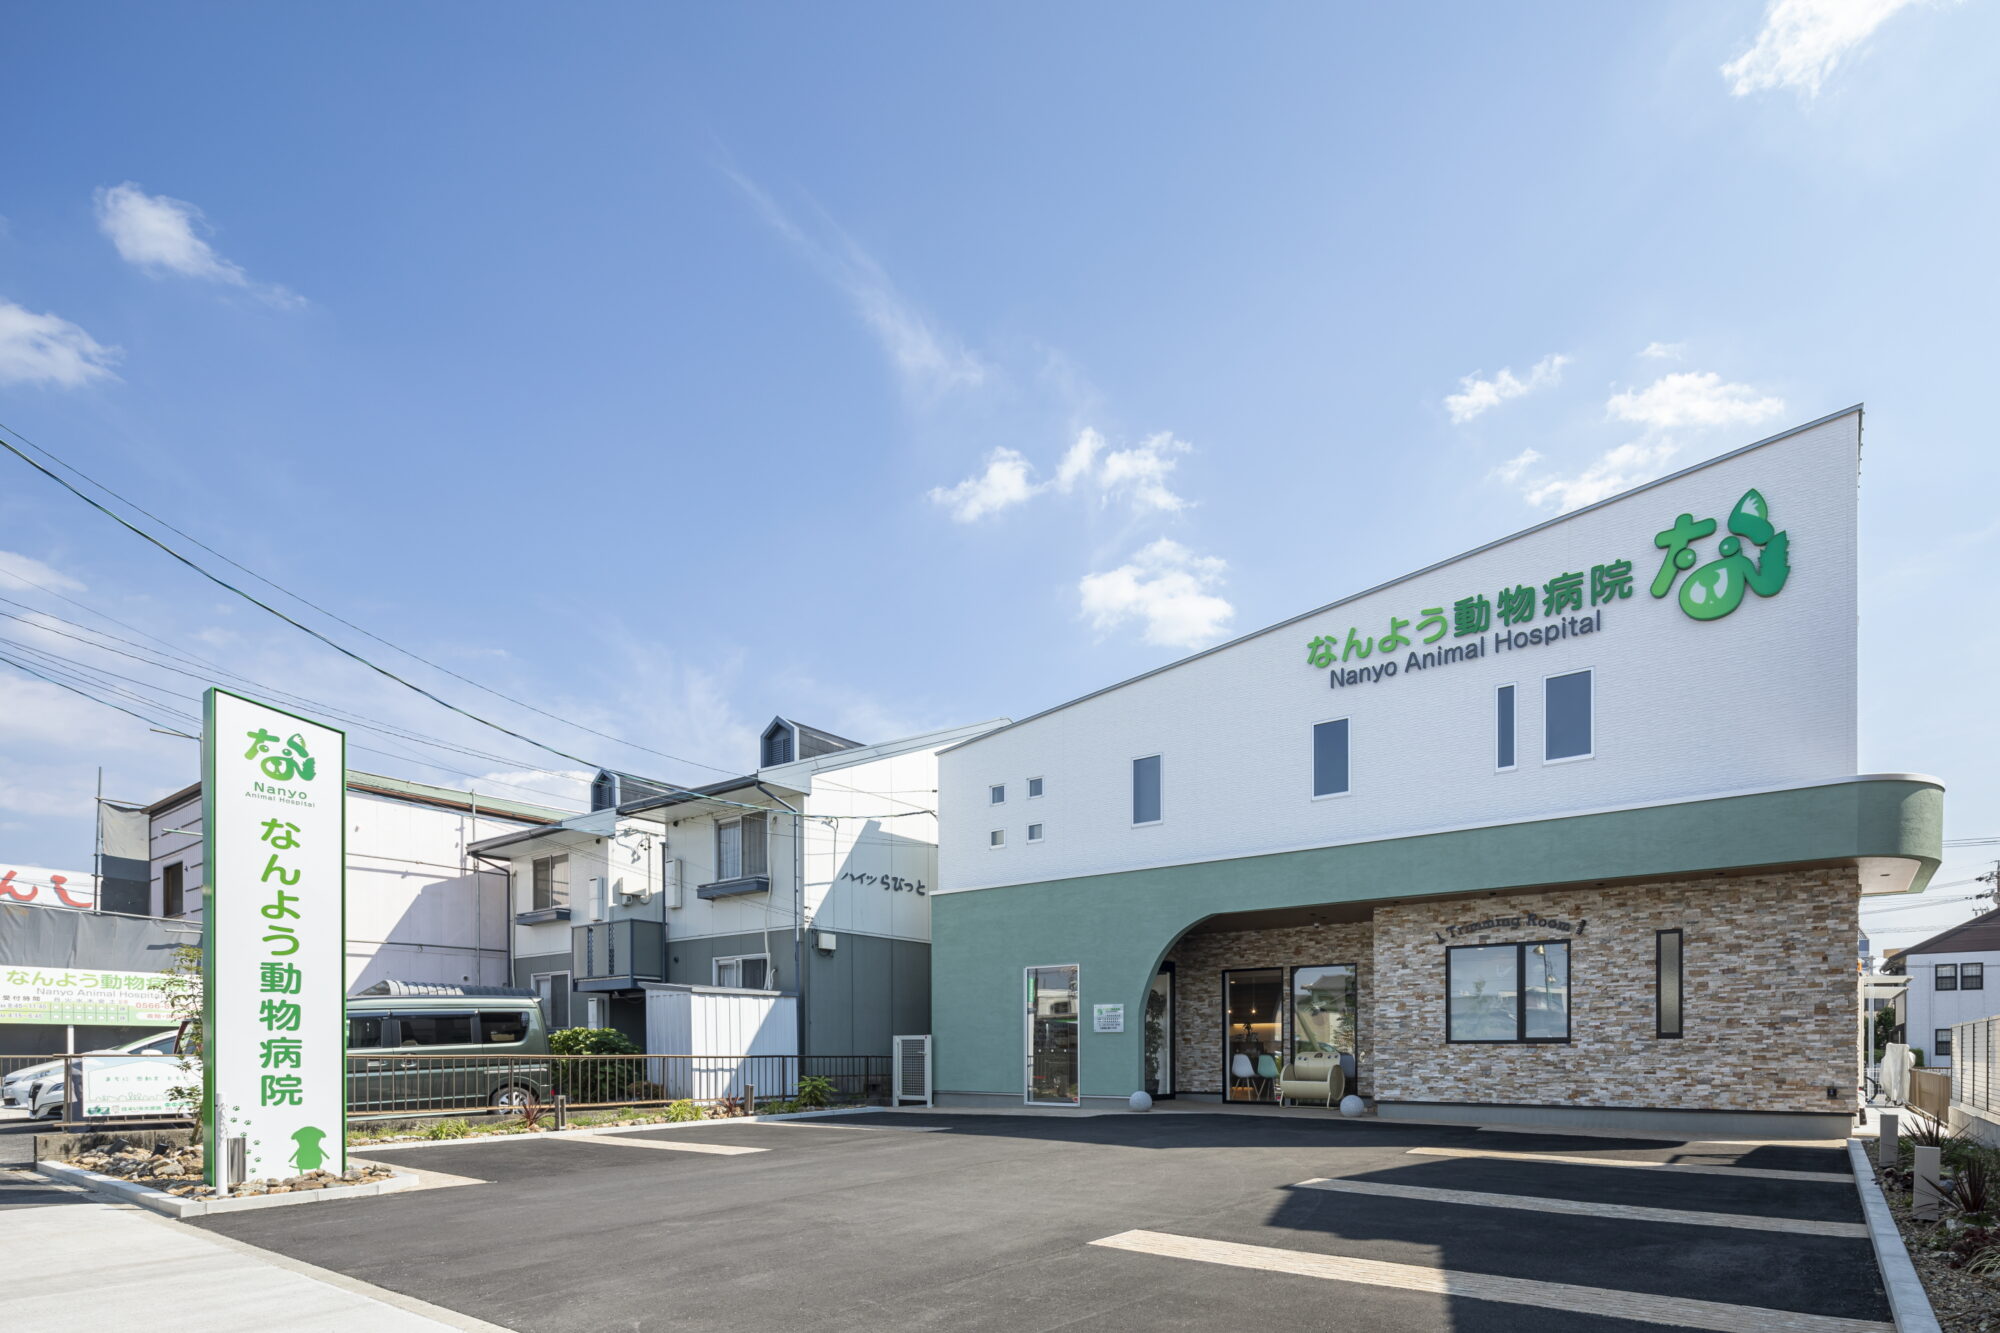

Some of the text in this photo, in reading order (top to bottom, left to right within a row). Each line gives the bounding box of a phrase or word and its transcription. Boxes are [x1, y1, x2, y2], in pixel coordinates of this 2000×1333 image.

[1307, 559, 1633, 668] なんよう動物病院
[1330, 609, 1600, 689] Nanyo Animal Hospital
[245, 791, 316, 808] Animal Hospital
[254, 781, 307, 800] Nanyo
[1446, 914, 1571, 938] Trimming Room
[260, 818, 303, 1107] なんよう動物病院
[36, 987, 73, 996] Nanyo
[77, 989, 116, 998] Animal
